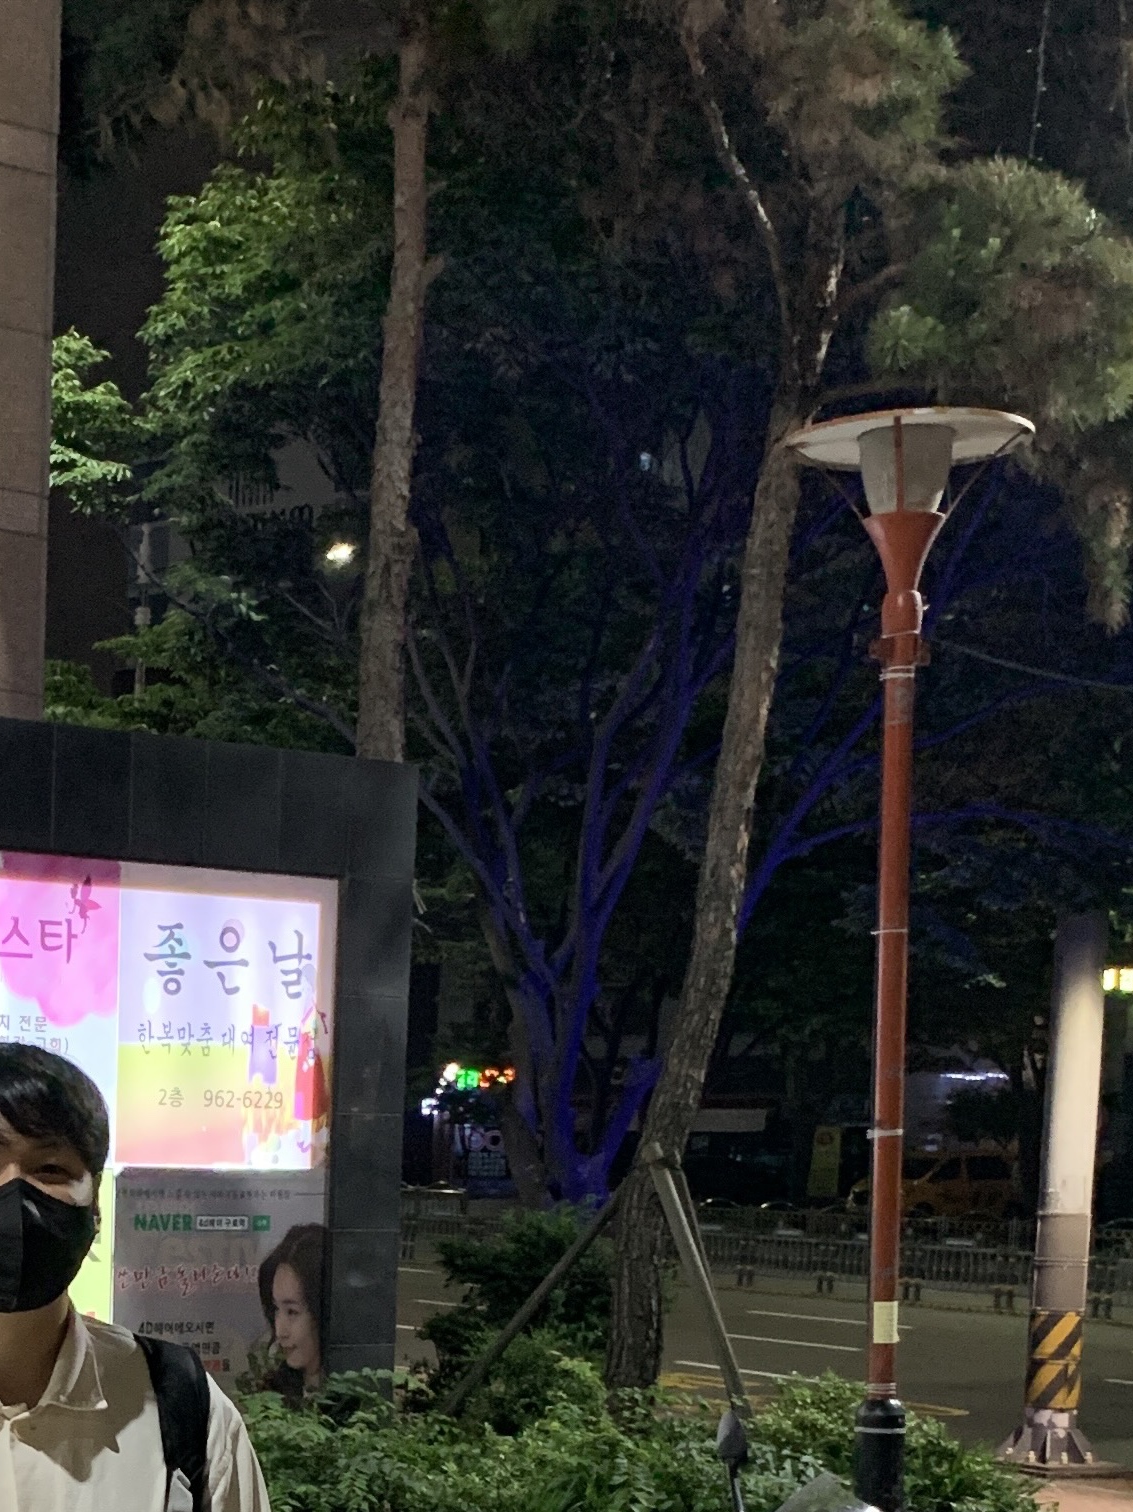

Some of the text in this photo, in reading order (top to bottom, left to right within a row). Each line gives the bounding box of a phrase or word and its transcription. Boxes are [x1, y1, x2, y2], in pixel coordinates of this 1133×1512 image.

[19, 1015, 47, 1032] 전문
[204, 1089, 283, 1109] 962-6229
[134, 1213, 193, 1232] NAVER
